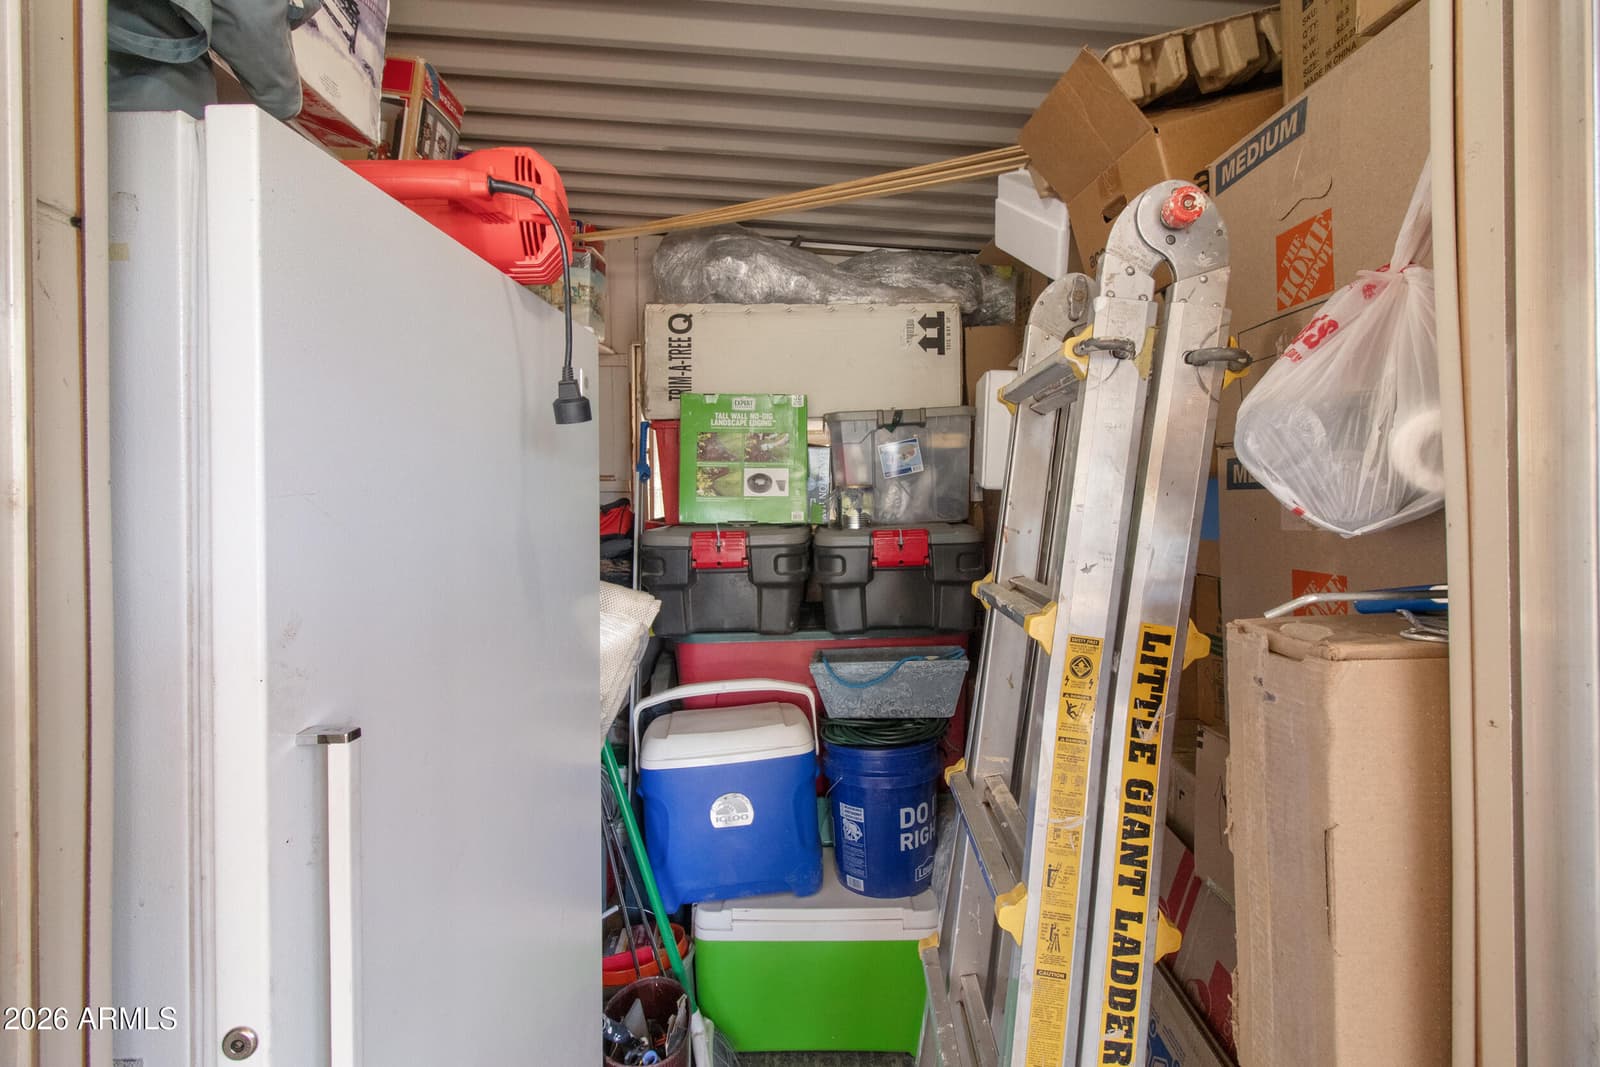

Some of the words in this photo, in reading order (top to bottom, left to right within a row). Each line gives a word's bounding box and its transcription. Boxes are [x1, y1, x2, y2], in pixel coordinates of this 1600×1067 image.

[1333, 40, 1357, 65] CHINA
[1221, 111, 1299, 186] MEDIUM
[1277, 214, 1334, 308] HOME
[1281, 234, 1304, 269] THE
[1299, 241, 1334, 302] DEPOT
[1128, 631, 1172, 766] LITTLE
[716, 813, 749, 825] IGLOO
[900, 802, 929, 829] DO
[900, 821, 936, 852] RIGH
[1118, 778, 1154, 897] GIANT
[1037, 970, 1065, 979] CAUTION
[1103, 908, 1144, 1066] LADDER
